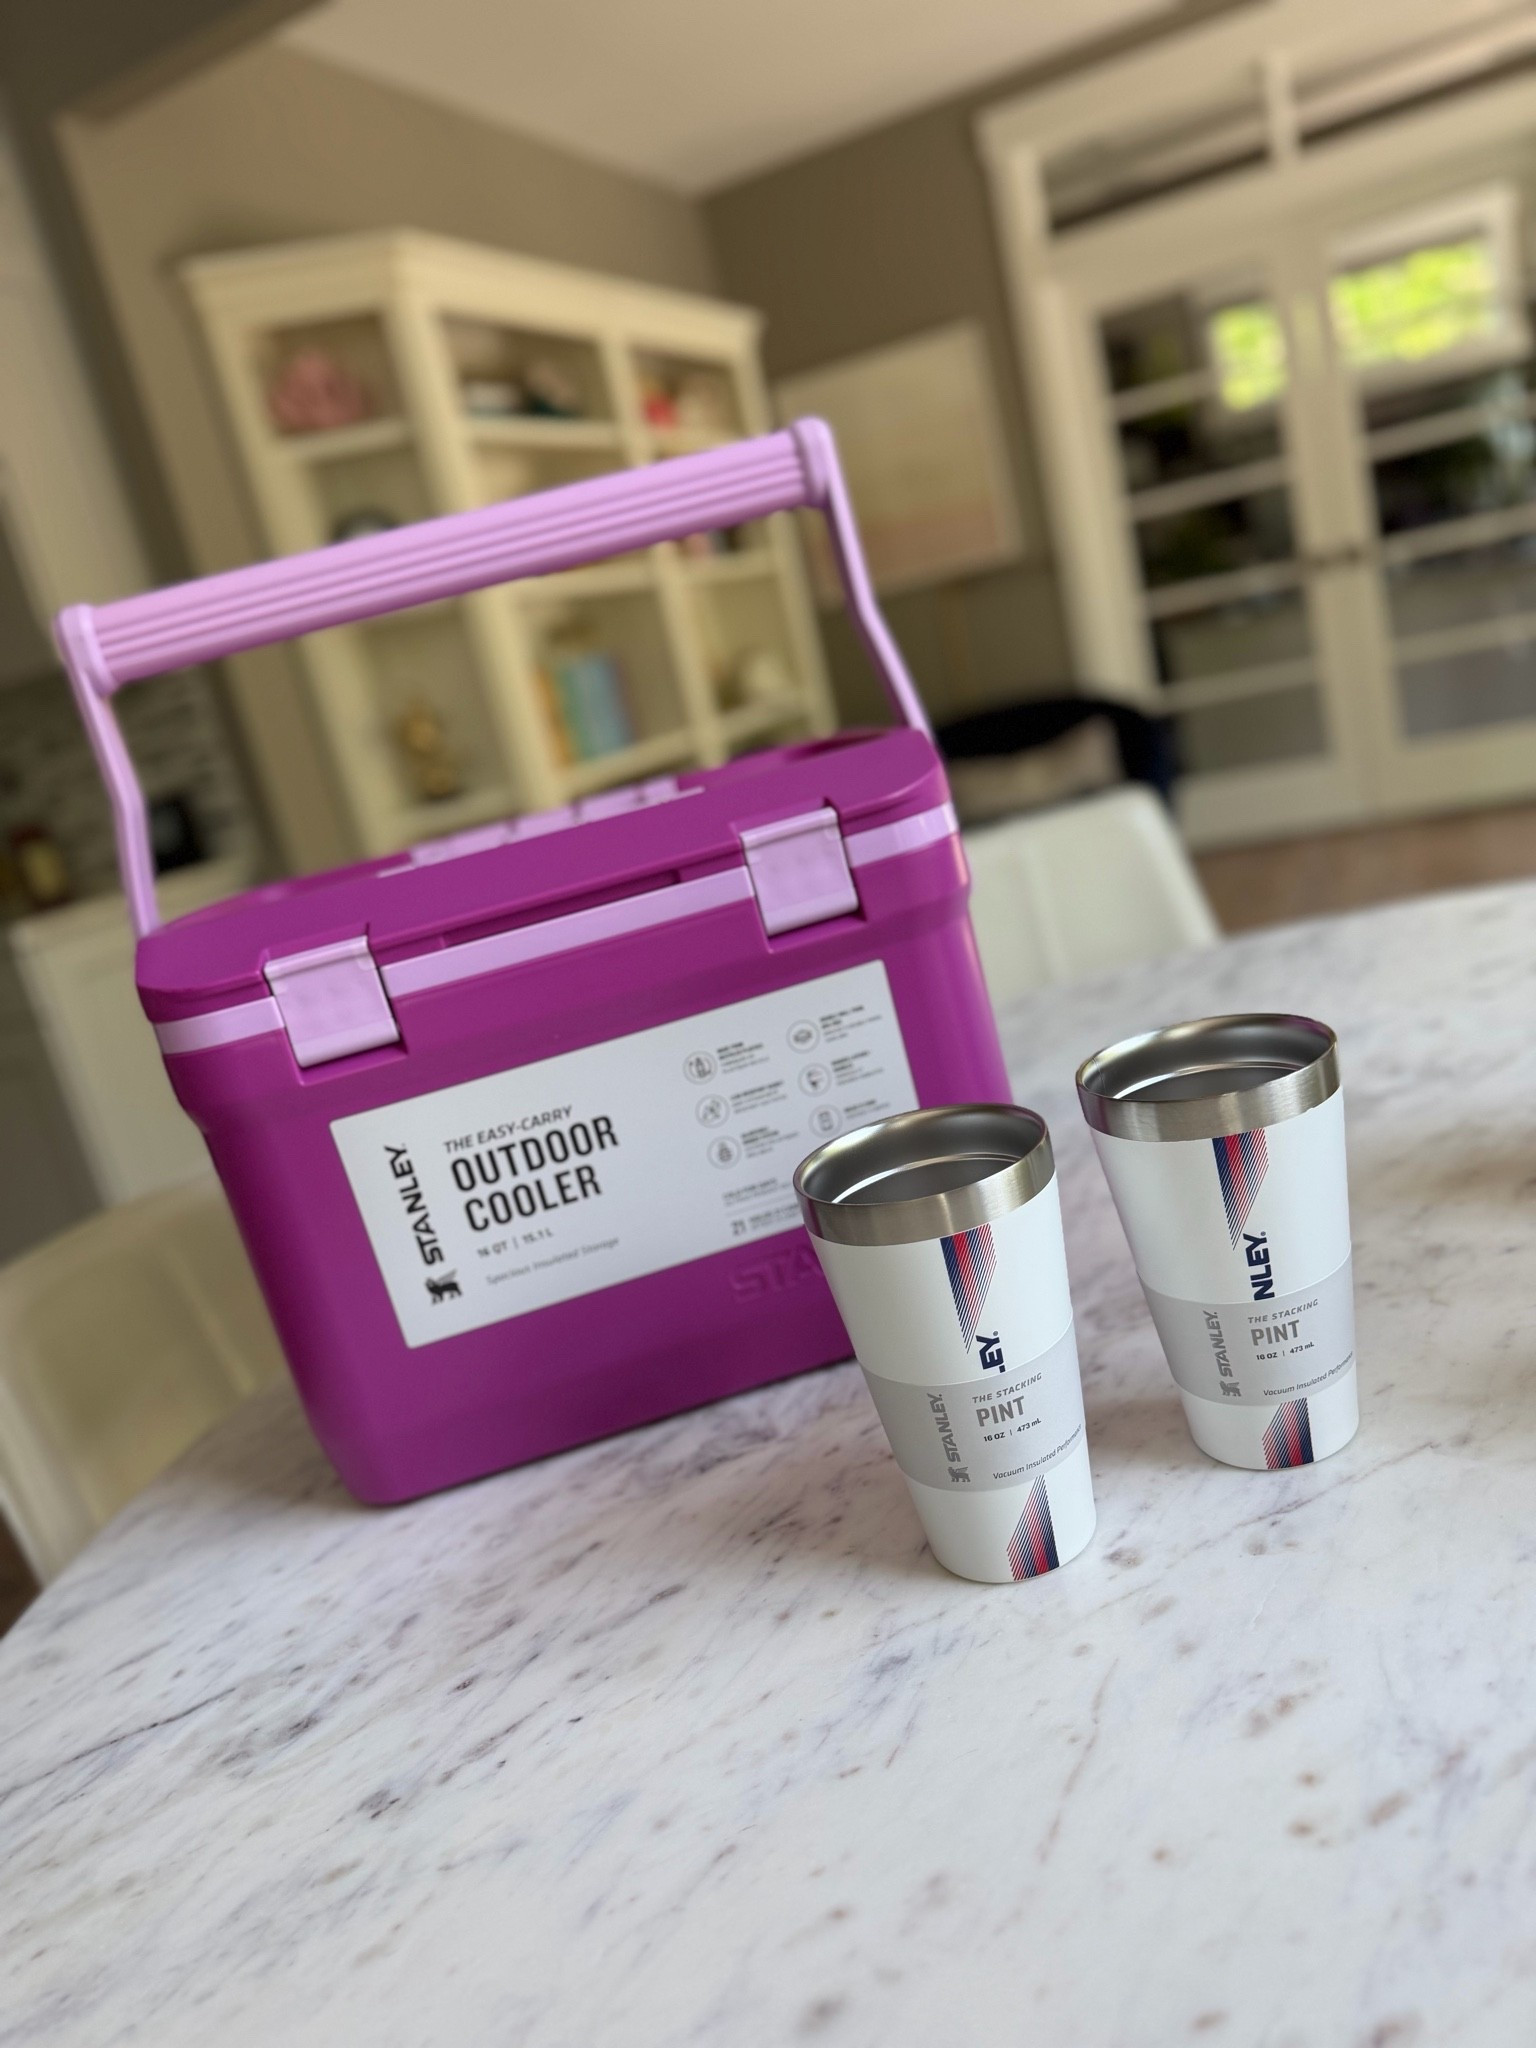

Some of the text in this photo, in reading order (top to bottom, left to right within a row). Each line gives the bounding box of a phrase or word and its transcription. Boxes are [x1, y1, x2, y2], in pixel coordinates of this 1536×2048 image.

[443, 1105, 573, 1154] THE EASY-CARRY
[450, 1115, 619, 1192] OUTDOOR
[384, 1144, 445, 1266] STANLEY
[464, 1164, 603, 1233] COOLER
[1247, 1299, 1319, 1324] THE STACKING
[1203, 1310, 1234, 1378] STANLEY
[1250, 1319, 1301, 1347] PINT
[1256, 1341, 1315, 1361] 16 OZ 473 mL
[972, 1372, 1042, 1404] THE STACKING
[1263, 1386, 1295, 1397] Vacuum
[1296, 1372, 1328, 1391] Insulated
[927, 1392, 961, 1463] STANLEY
[976, 1395, 1025, 1428] PINT
[983, 1417, 1042, 1442] 16 OZ 473 mL
[992, 1466, 1025, 1480] Vacuum
[1026, 1449, 1056, 1471] Insulated
